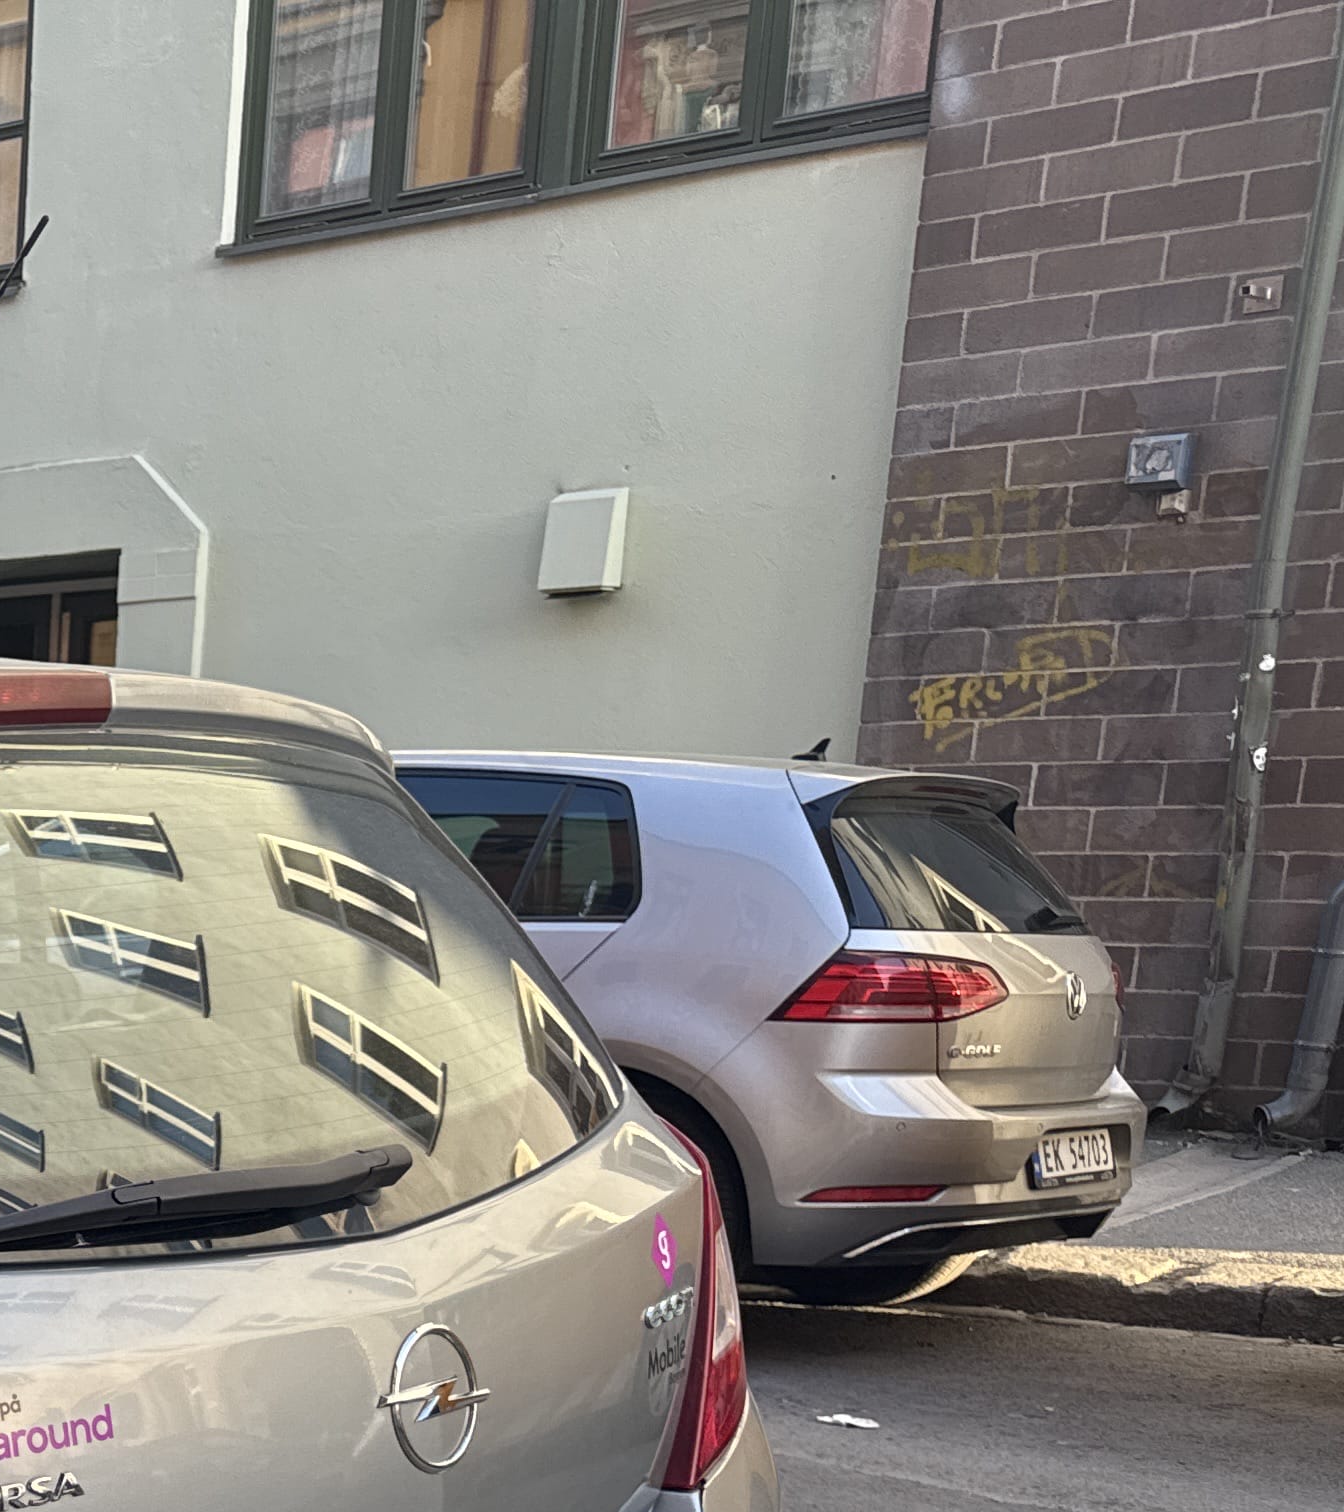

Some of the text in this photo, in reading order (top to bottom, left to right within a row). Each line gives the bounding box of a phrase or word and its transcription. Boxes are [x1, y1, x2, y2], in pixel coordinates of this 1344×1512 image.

[1041, 1133, 1109, 1174] EK 54703
[657, 1229, 671, 1270] g
[647, 1333, 686, 1379] Mobile
[0, 1393, 22, 1422] på
